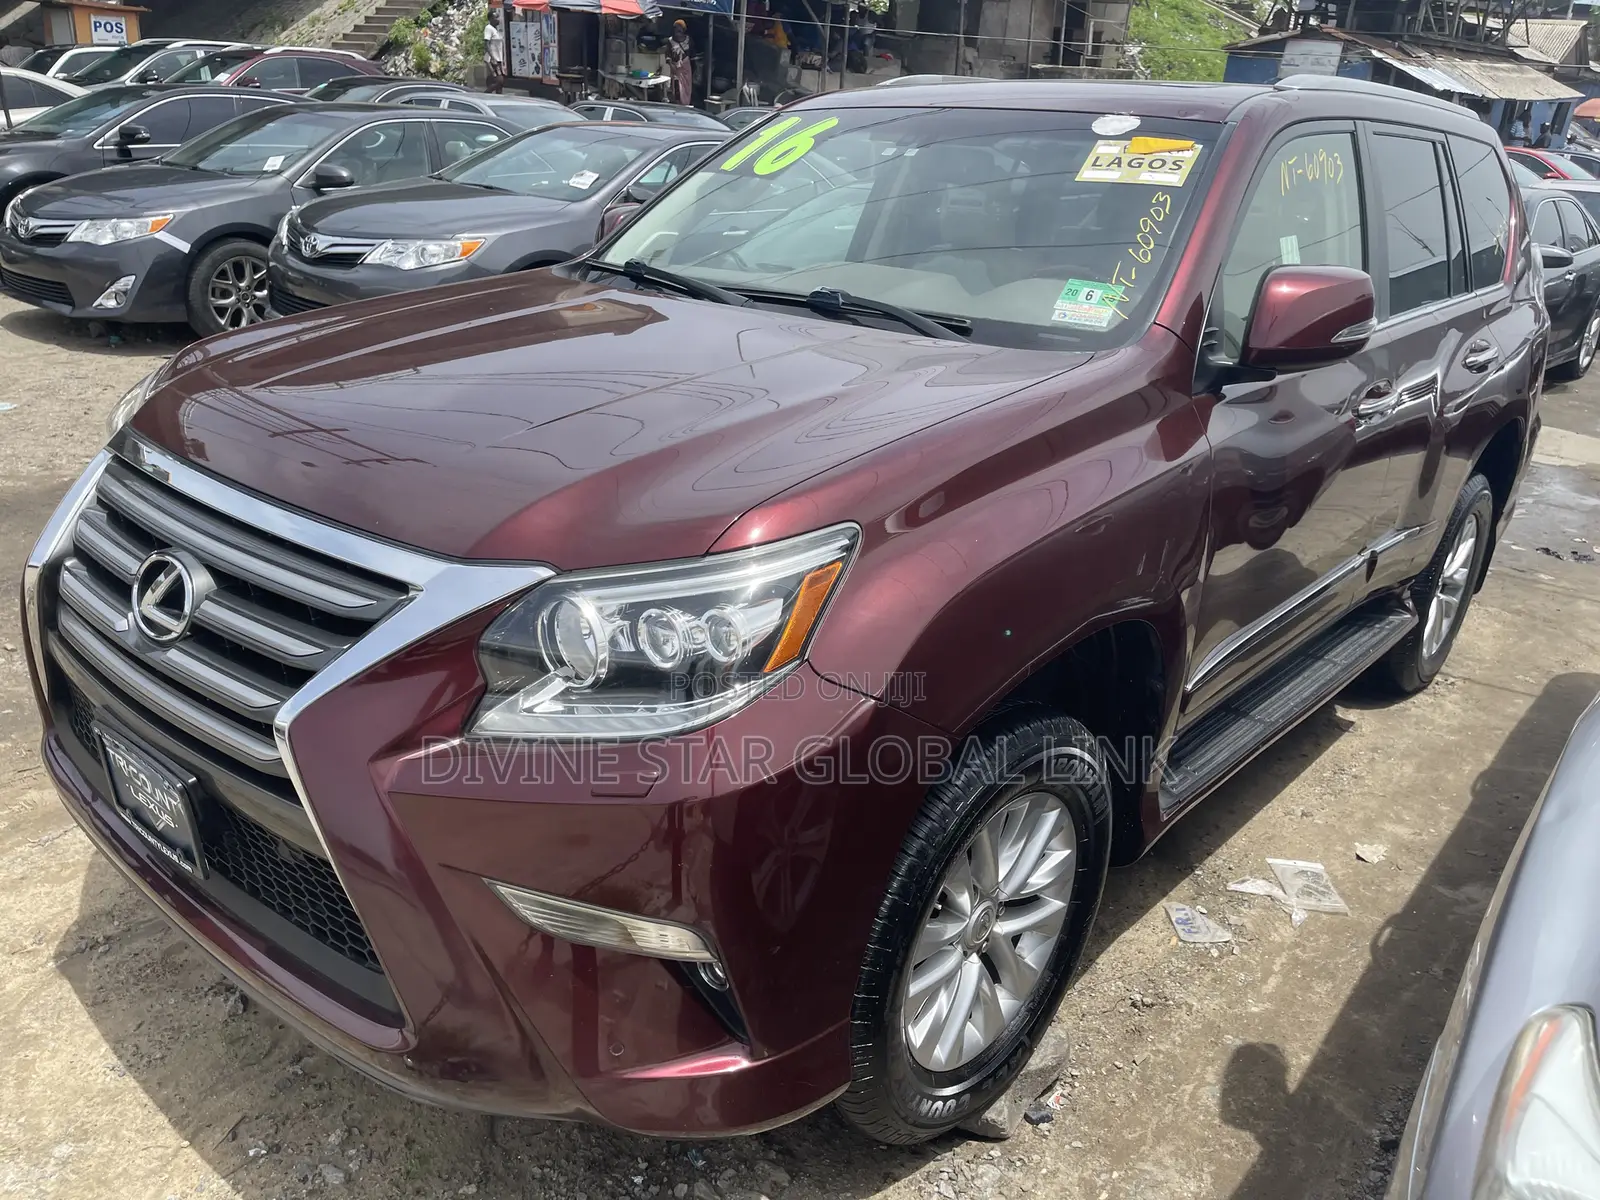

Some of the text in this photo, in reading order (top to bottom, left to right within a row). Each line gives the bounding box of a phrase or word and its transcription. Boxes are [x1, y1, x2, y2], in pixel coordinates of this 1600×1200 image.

[93, 20, 124, 34] POS
[719, 116, 839, 176] 16
[1091, 155, 1185, 171] LAGOS
[1065, 288, 1079, 297] 20
[1085, 289, 1095, 302] 6
